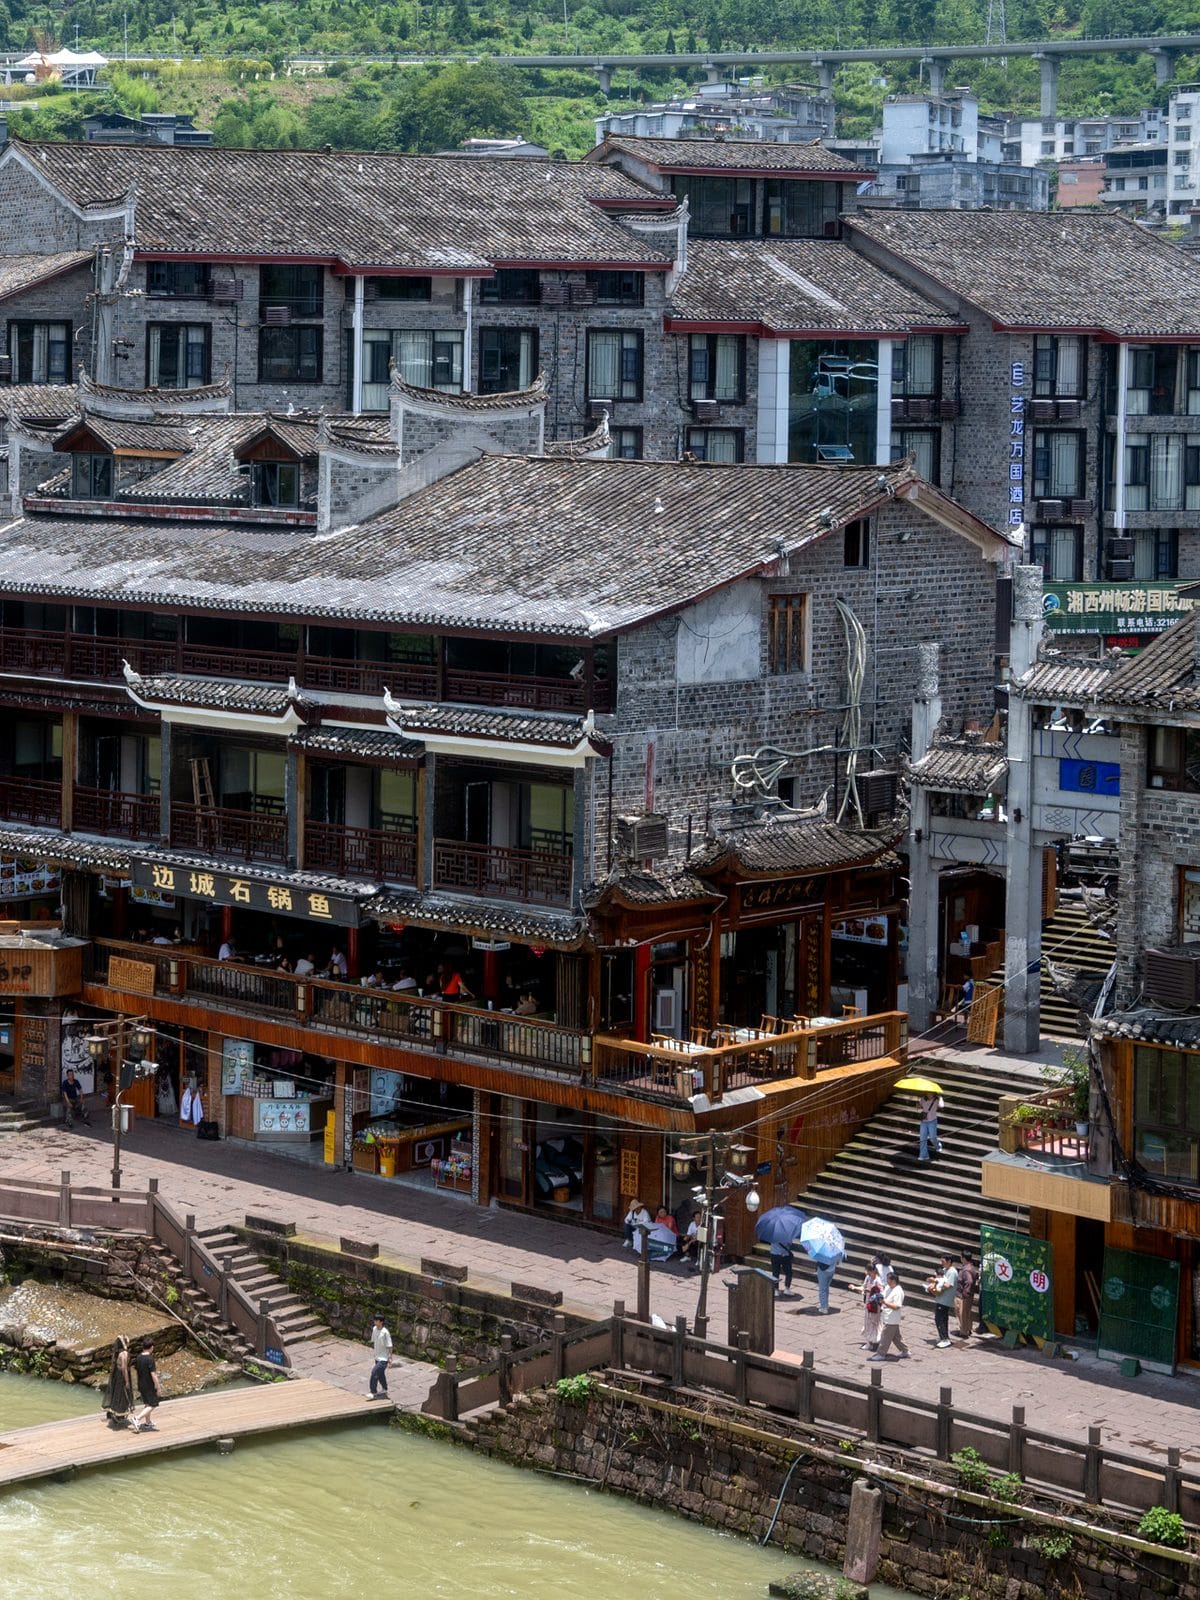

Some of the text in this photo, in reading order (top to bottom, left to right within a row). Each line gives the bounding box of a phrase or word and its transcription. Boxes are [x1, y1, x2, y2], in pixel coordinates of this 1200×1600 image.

[152, 864, 332, 919] 边城石锅鱼
